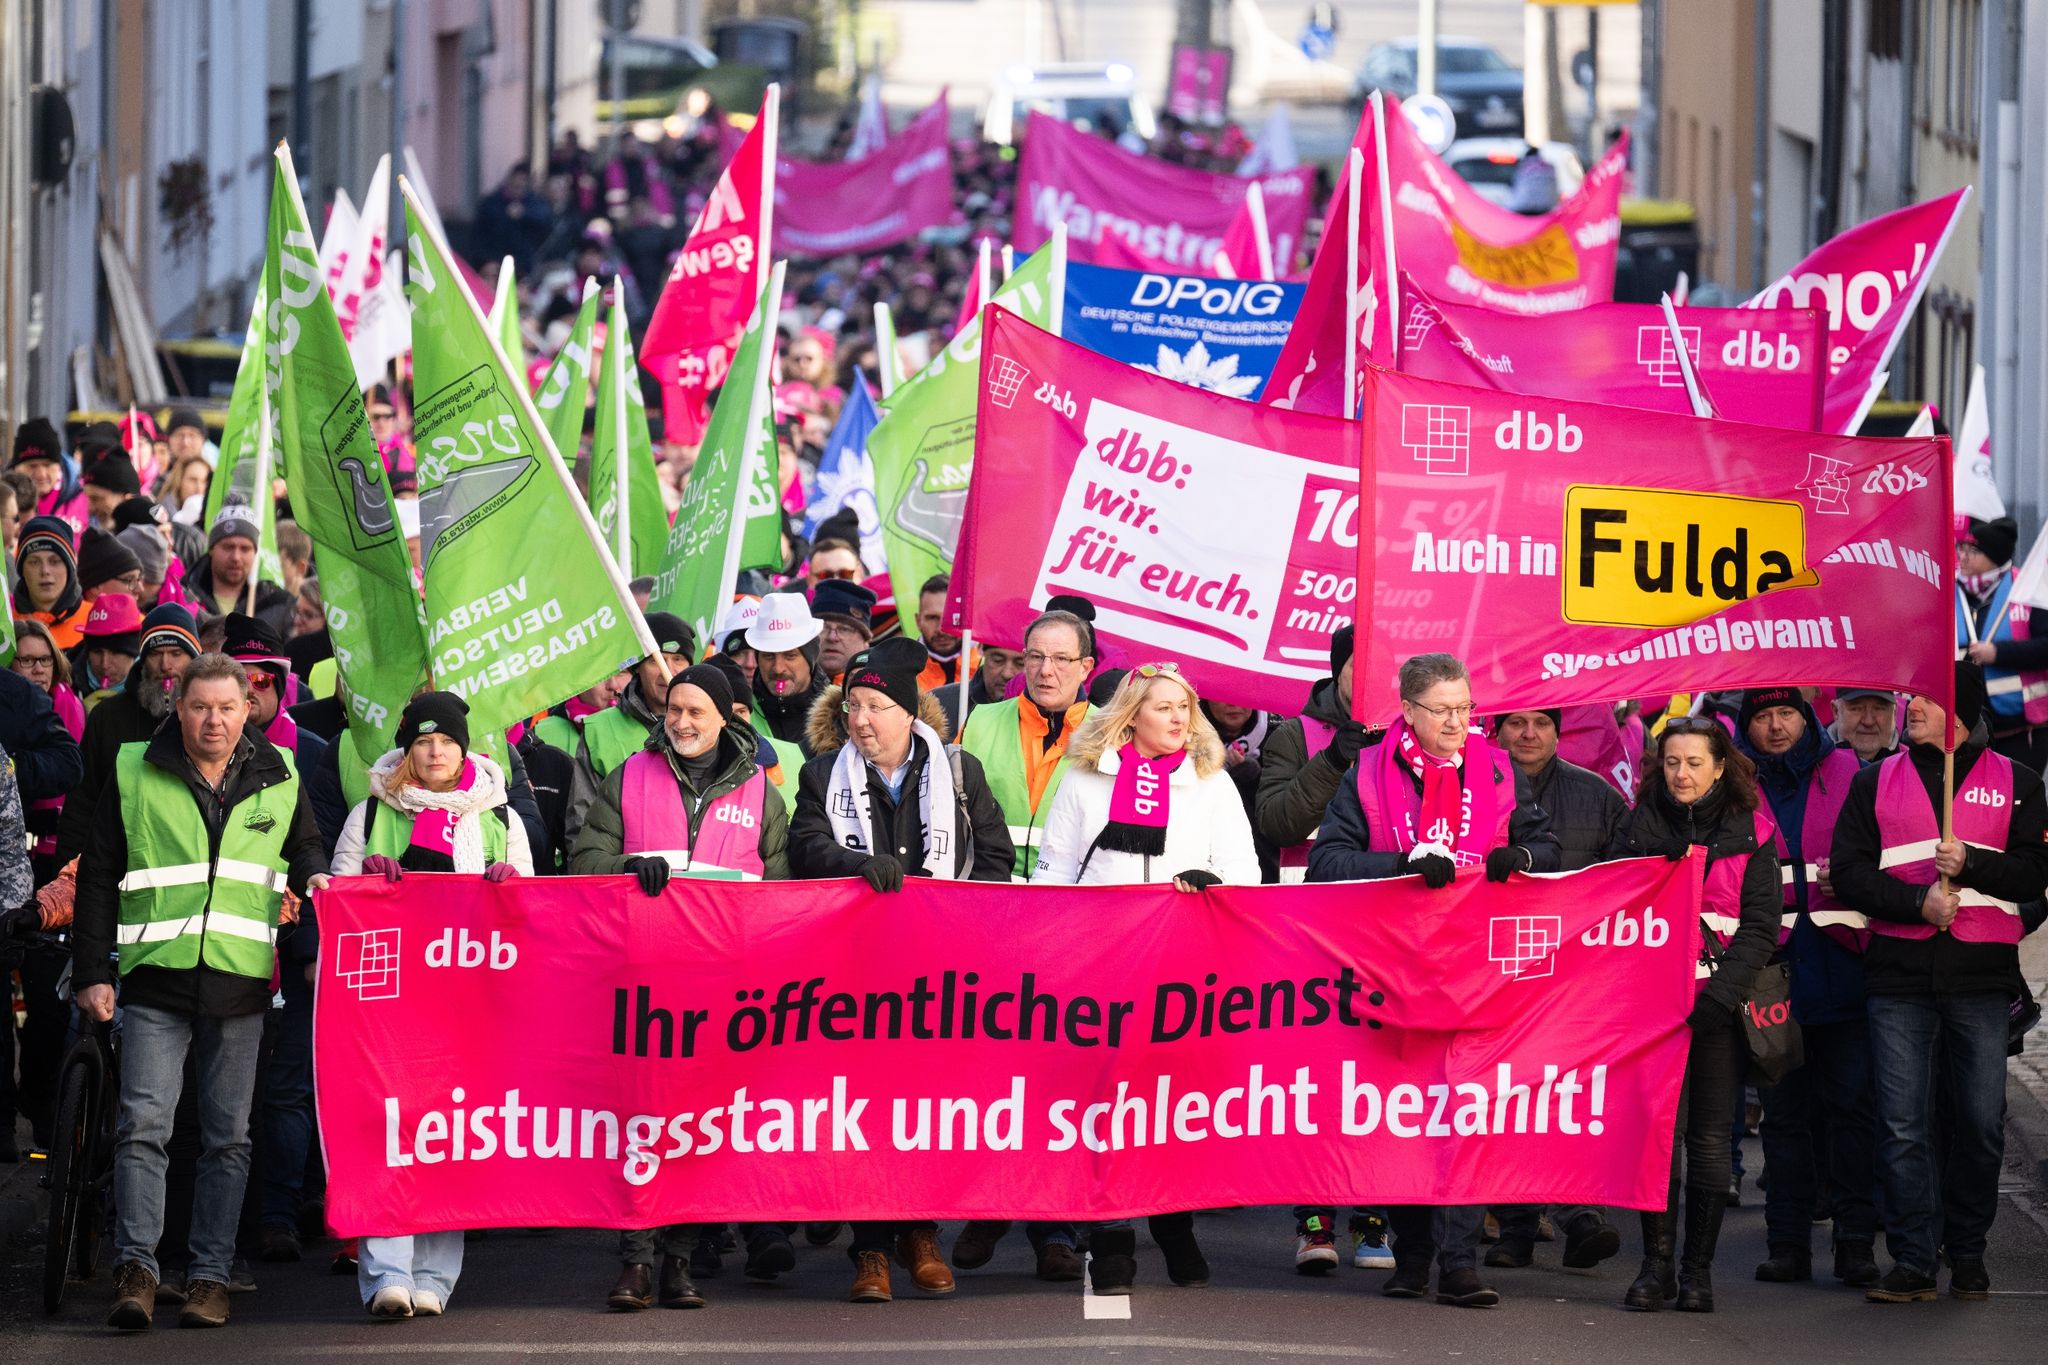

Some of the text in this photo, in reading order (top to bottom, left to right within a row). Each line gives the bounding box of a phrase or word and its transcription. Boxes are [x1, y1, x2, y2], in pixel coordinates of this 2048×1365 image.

[1080, 306, 1155, 325] DEUTSCHE
[1130, 274, 1285, 316] DPolG
[1722, 329, 1801, 371] dbb
[1494, 410, 1583, 453] dbb
[1095, 428, 1194, 490] dbb:
[1862, 462, 1928, 496] dbb
[1082, 480, 1160, 535] wir.
[1050, 525, 1261, 621] für euch.
[1411, 532, 1510, 574] Auch
[1519, 536, 1557, 577] in
[1579, 508, 1794, 601] Fulda
[1899, 546, 1941, 591] wir
[768, 619, 792, 631] dbb
[1134, 762, 1160, 816] dbb
[1964, 786, 2006, 808] dbb
[714, 803, 756, 829] dbb
[1580, 905, 1670, 949] dbb
[424, 928, 519, 971] dbb
[611, 966, 1386, 1059] Ihr öffentlicher Dienst:
[385, 1060, 1607, 1187] Leistungsstark und schlecht bezahlt!
